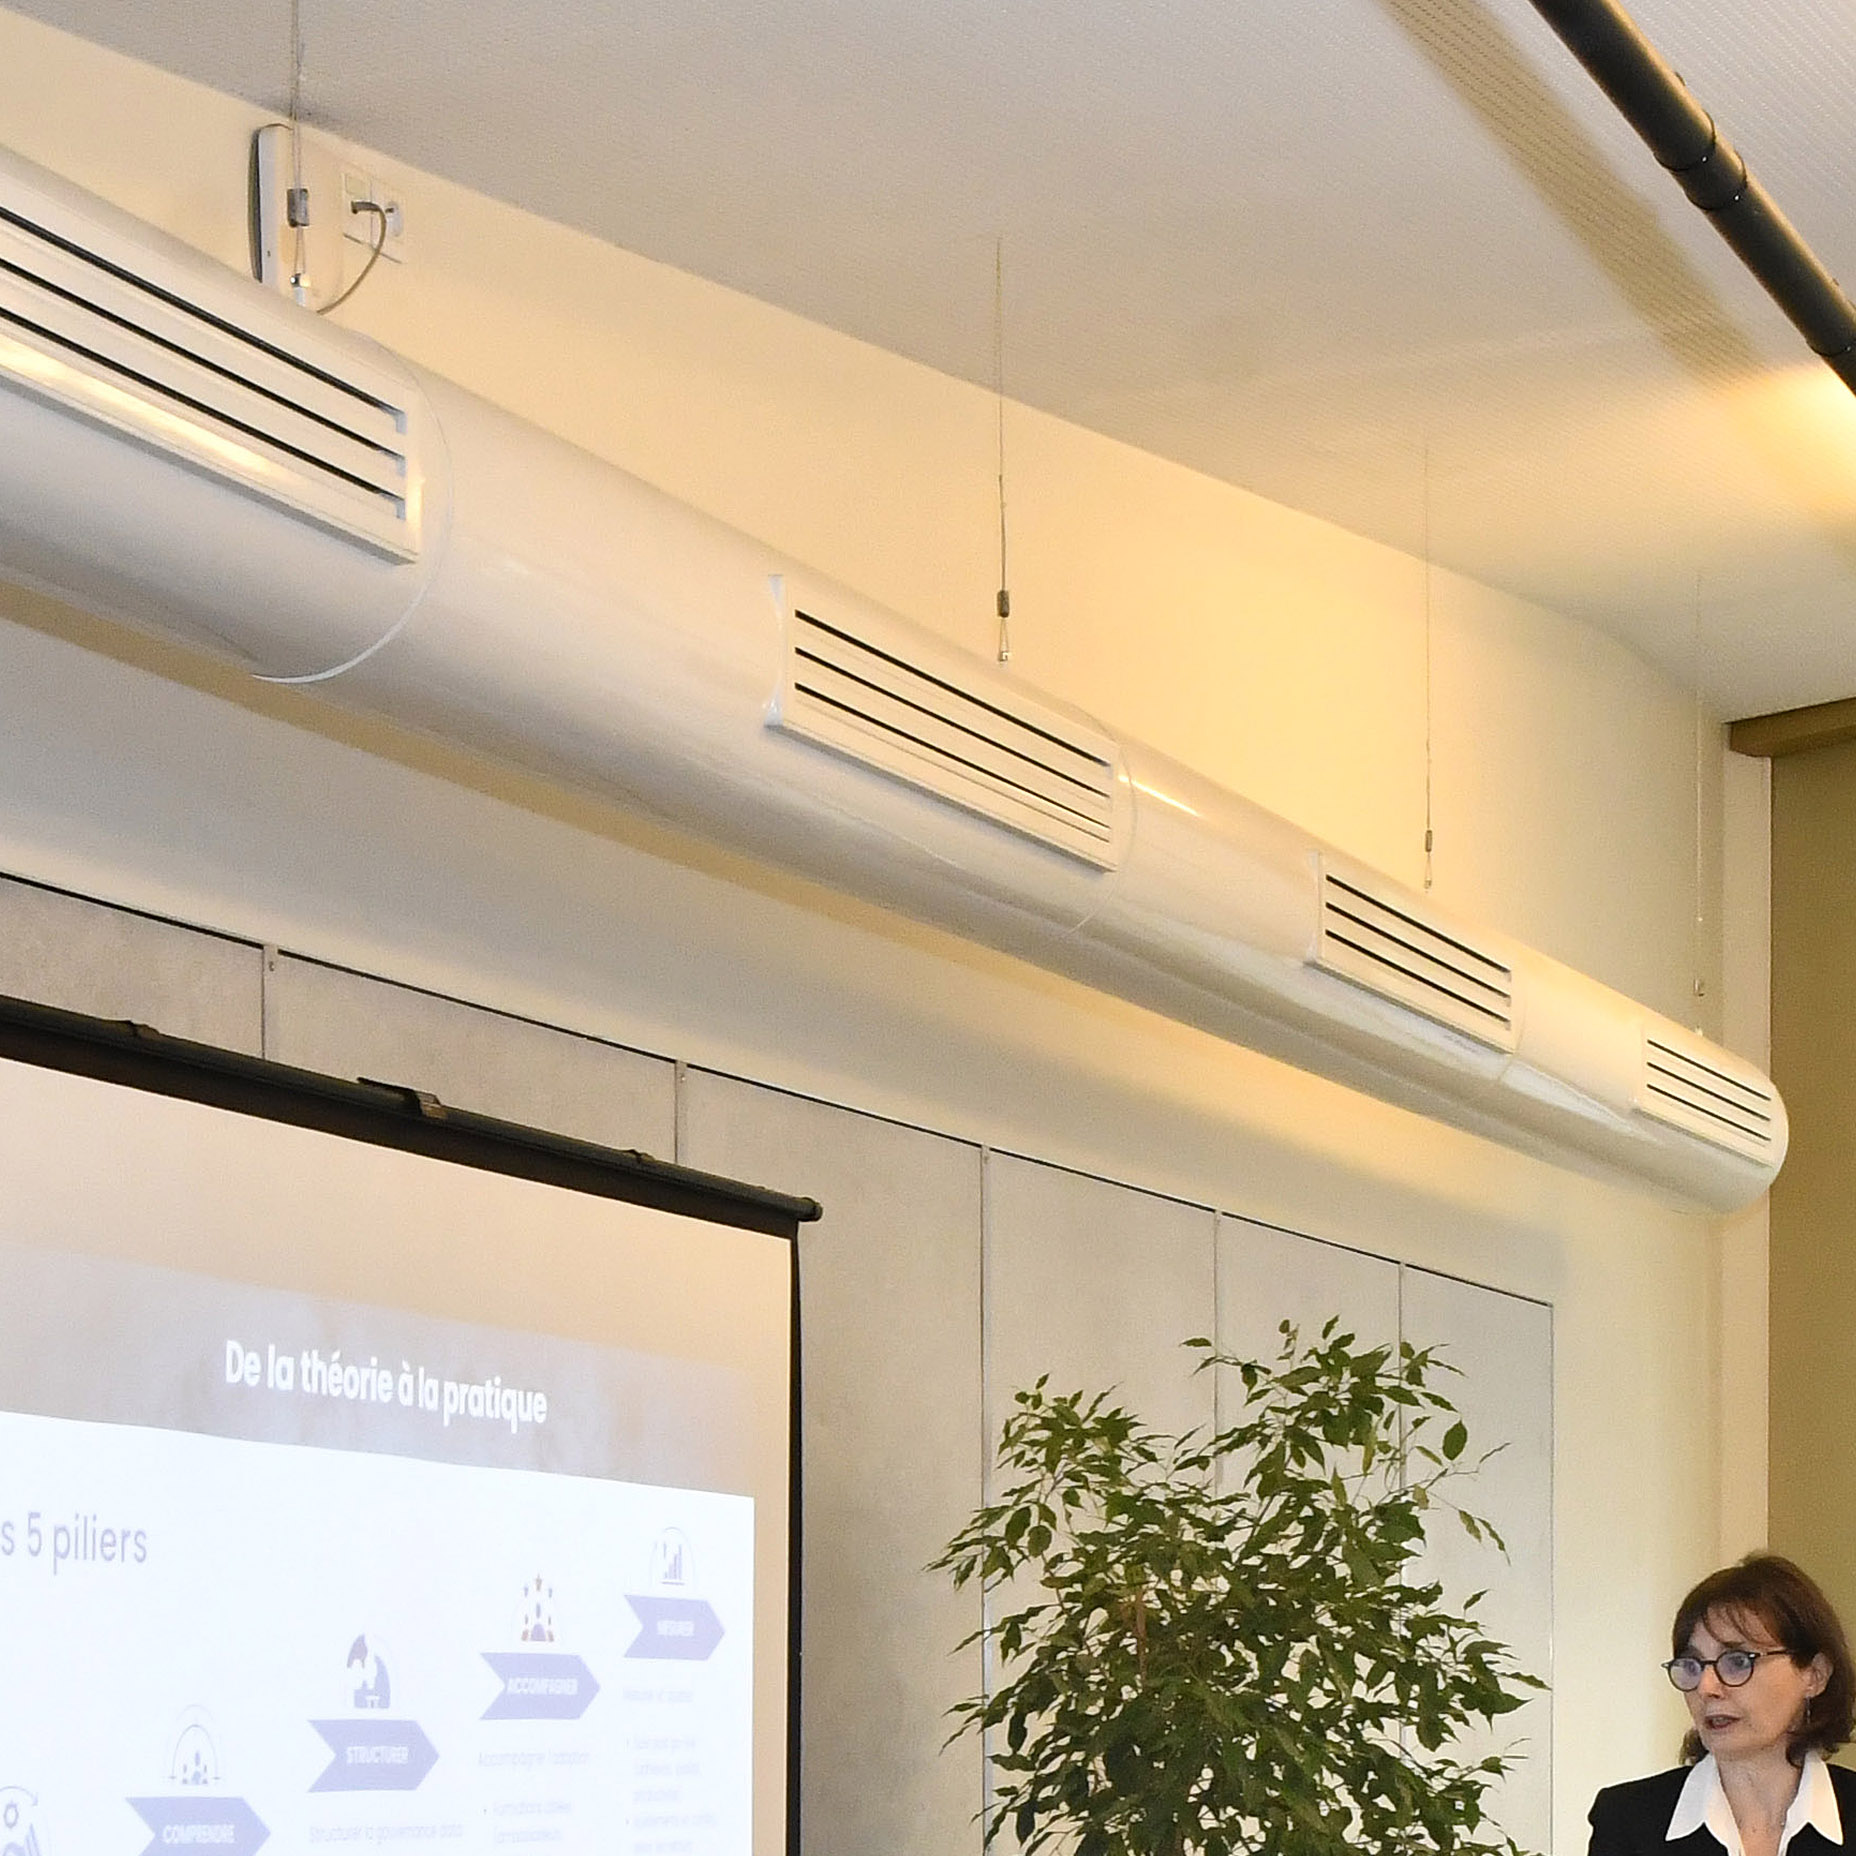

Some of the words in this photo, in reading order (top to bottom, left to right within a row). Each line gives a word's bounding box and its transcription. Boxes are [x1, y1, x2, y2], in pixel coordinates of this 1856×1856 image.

[226, 1340, 261, 1387] De
[267, 1344, 294, 1390] la
[301, 1350, 393, 1403] théorie
[398, 1360, 414, 1406] à
[419, 1366, 439, 1410] la
[444, 1376, 547, 1434] pratique
[28, 1511, 42, 1557] 5
[53, 1512, 147, 1576] piliers
[346, 1745, 409, 1765] STRUCTURER
[163, 1824, 235, 1844] COMPRENDRE
